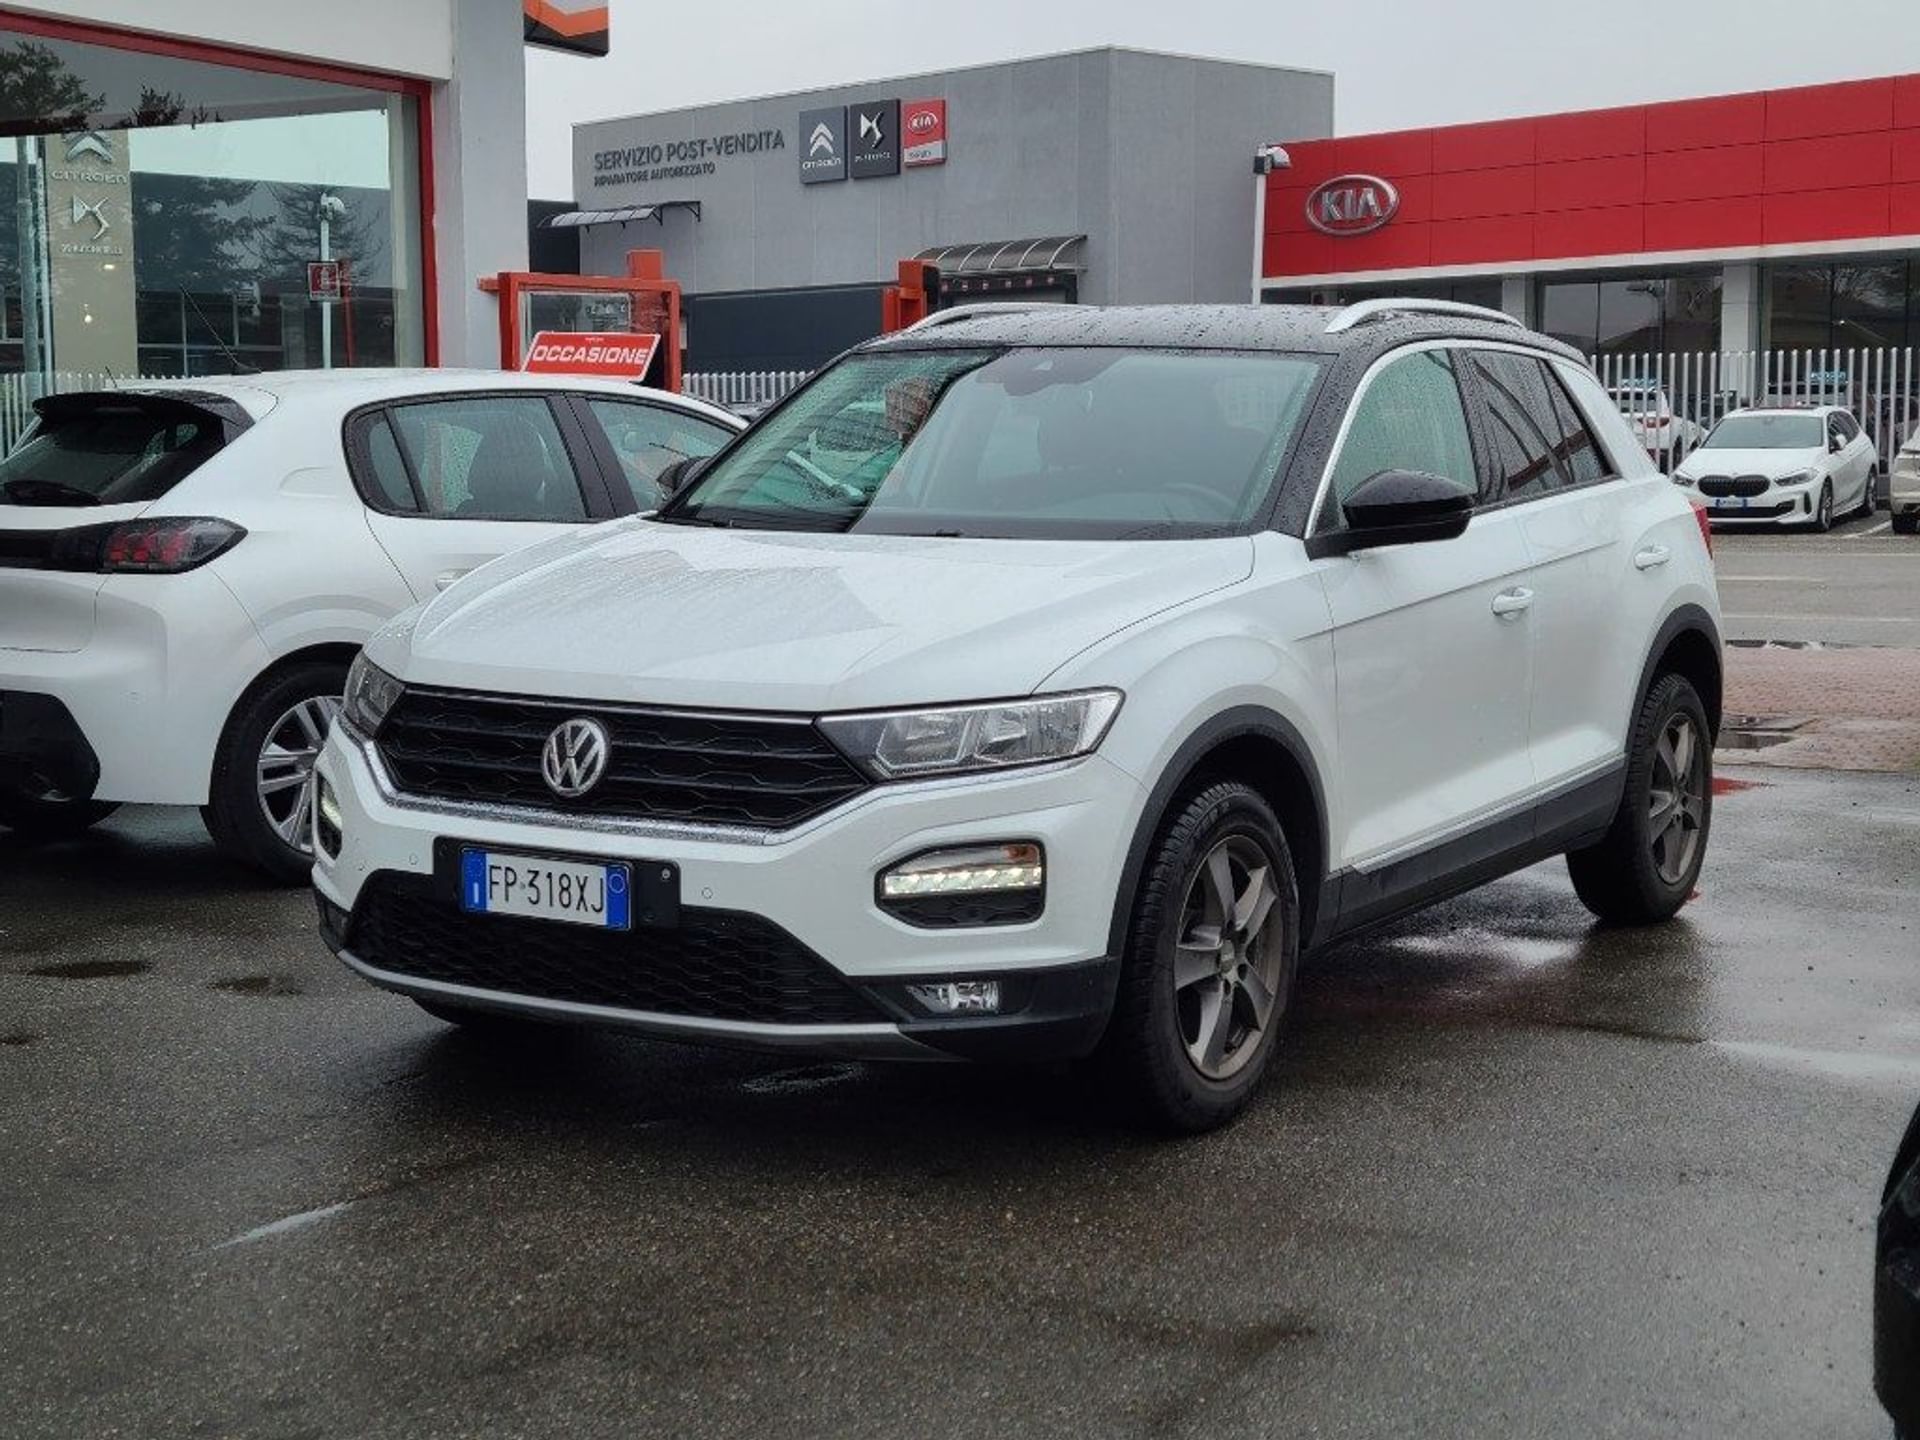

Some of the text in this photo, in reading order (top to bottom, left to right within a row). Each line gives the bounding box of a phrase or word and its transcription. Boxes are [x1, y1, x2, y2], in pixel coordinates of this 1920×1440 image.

[594, 129, 785, 171] SERVIZIO POST-VENDITA
[594, 161, 716, 187] RIPARATORE AUTORIZZATO
[1322, 187, 1383, 221] KIA
[532, 345, 648, 365] OCCASIONE
